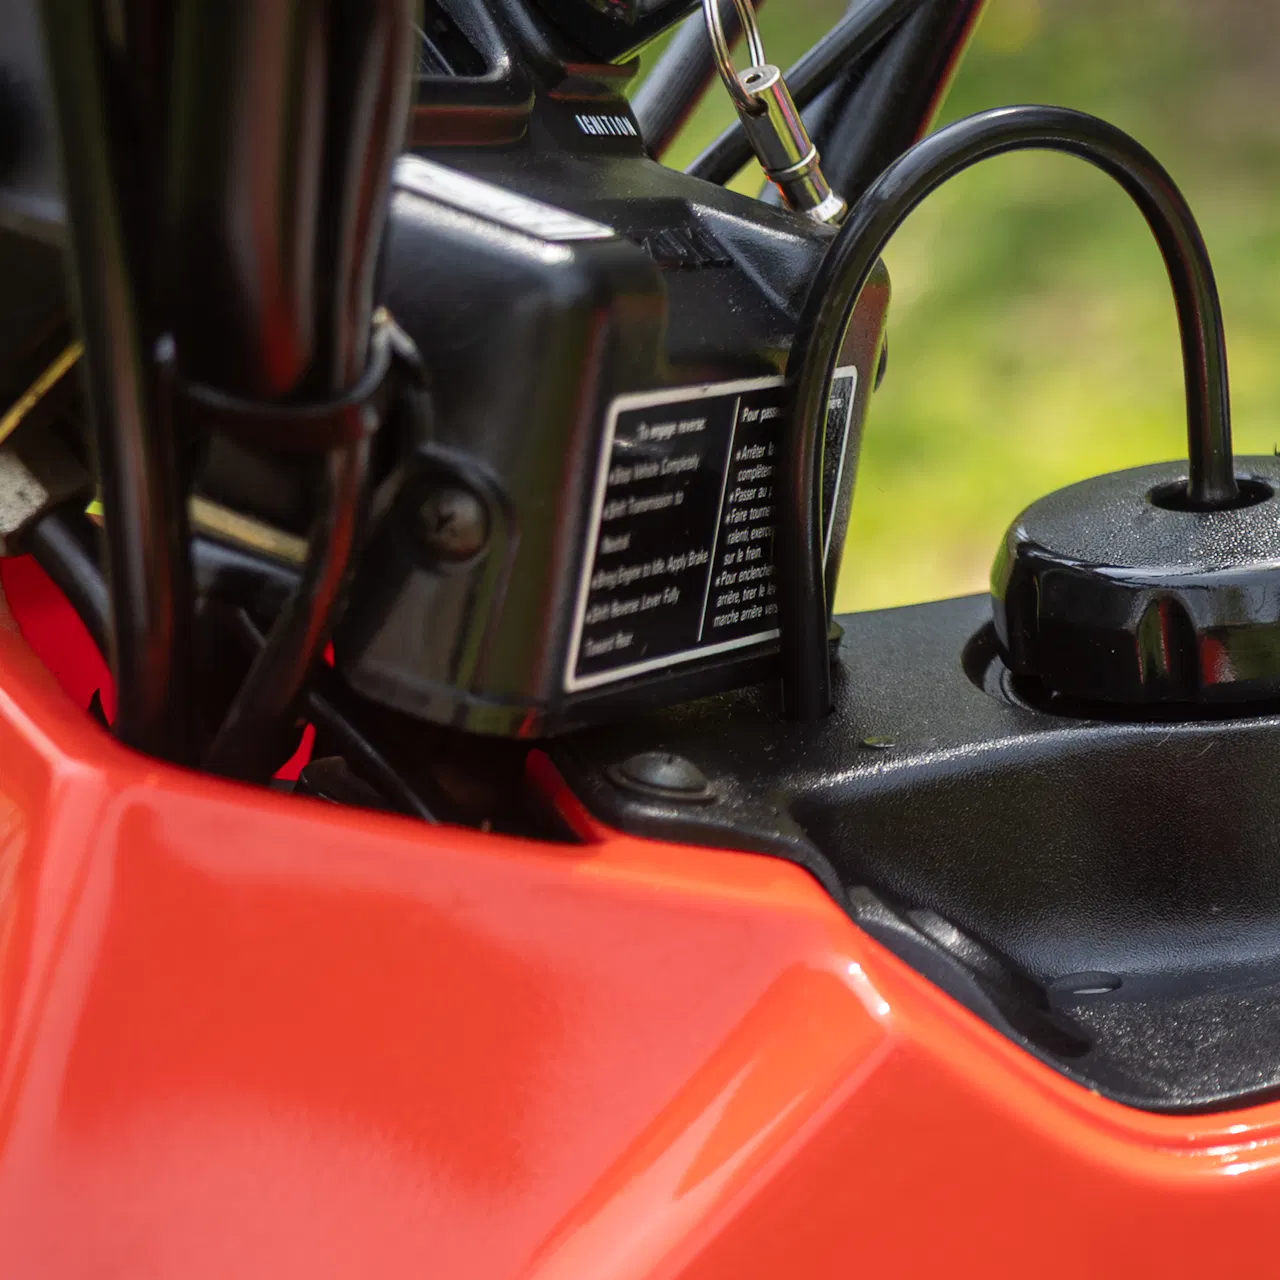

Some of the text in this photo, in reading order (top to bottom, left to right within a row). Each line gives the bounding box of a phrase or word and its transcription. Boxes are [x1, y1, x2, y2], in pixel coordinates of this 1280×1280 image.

[575, 114, 638, 137] IGNITION
[742, 407, 759, 423] Pour
[741, 444, 766, 461] Arrêter
[734, 486, 757, 502] Passer
[757, 486, 768, 499] au
[731, 507, 748, 523] Faire
[687, 548, 709, 567] Brake
[723, 553, 736, 565] sur
[736, 548, 744, 563] le
[720, 571, 737, 586] Pour
[742, 587, 758, 602] tirer
[758, 583, 766, 598] le
[713, 609, 739, 628] marche
[740, 604, 763, 621] arrière
